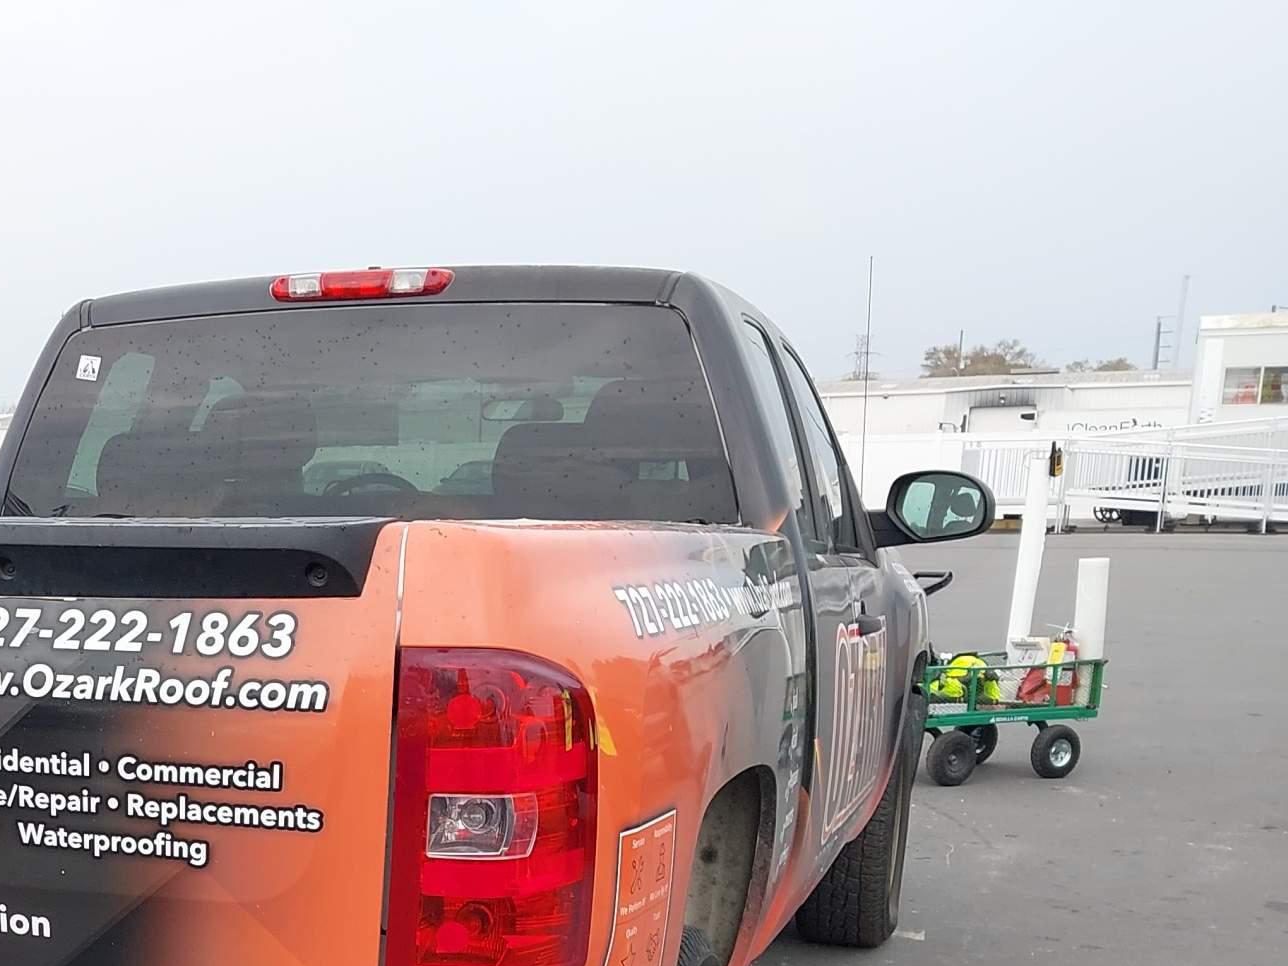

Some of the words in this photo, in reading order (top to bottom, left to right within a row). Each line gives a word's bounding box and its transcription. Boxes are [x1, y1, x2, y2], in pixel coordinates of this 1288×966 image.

[614, 577, 731, 637] 727-222-1863
[117, 756, 280, 791] Commercial
[126, 794, 321, 831] Replacements
[18, 822, 208, 867] Waterproofing
